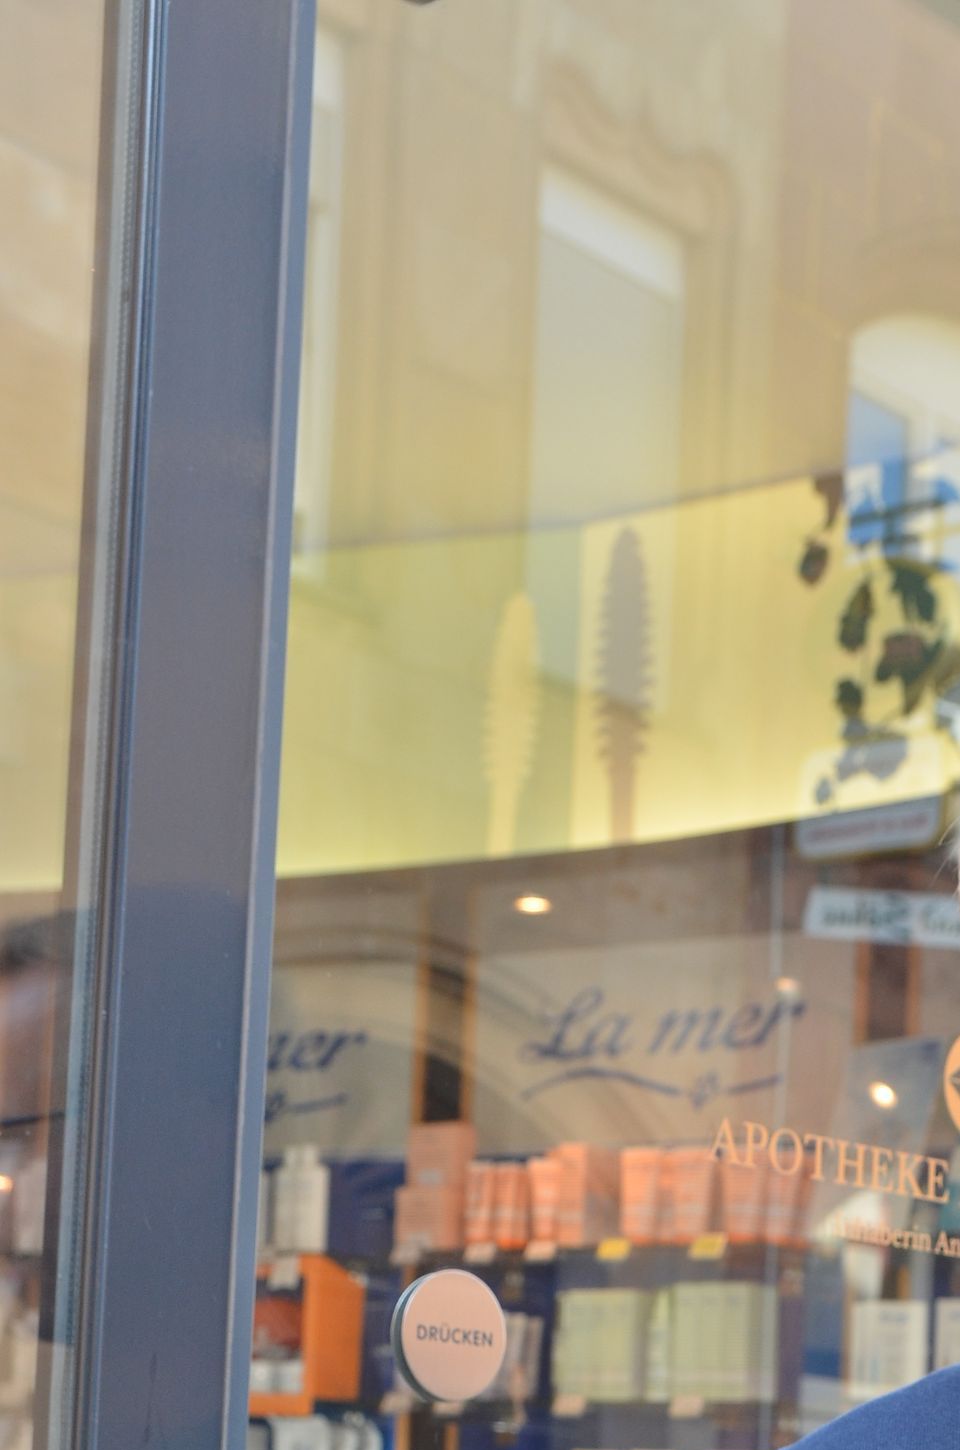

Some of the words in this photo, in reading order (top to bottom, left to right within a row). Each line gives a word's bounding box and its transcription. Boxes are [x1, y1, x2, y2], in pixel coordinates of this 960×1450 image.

[520, 986, 632, 1061] La
[647, 1001, 806, 1054] mer
[710, 1116, 950, 1204] APOTHEKE
[416, 1322, 494, 1347] DRÜCKEN
